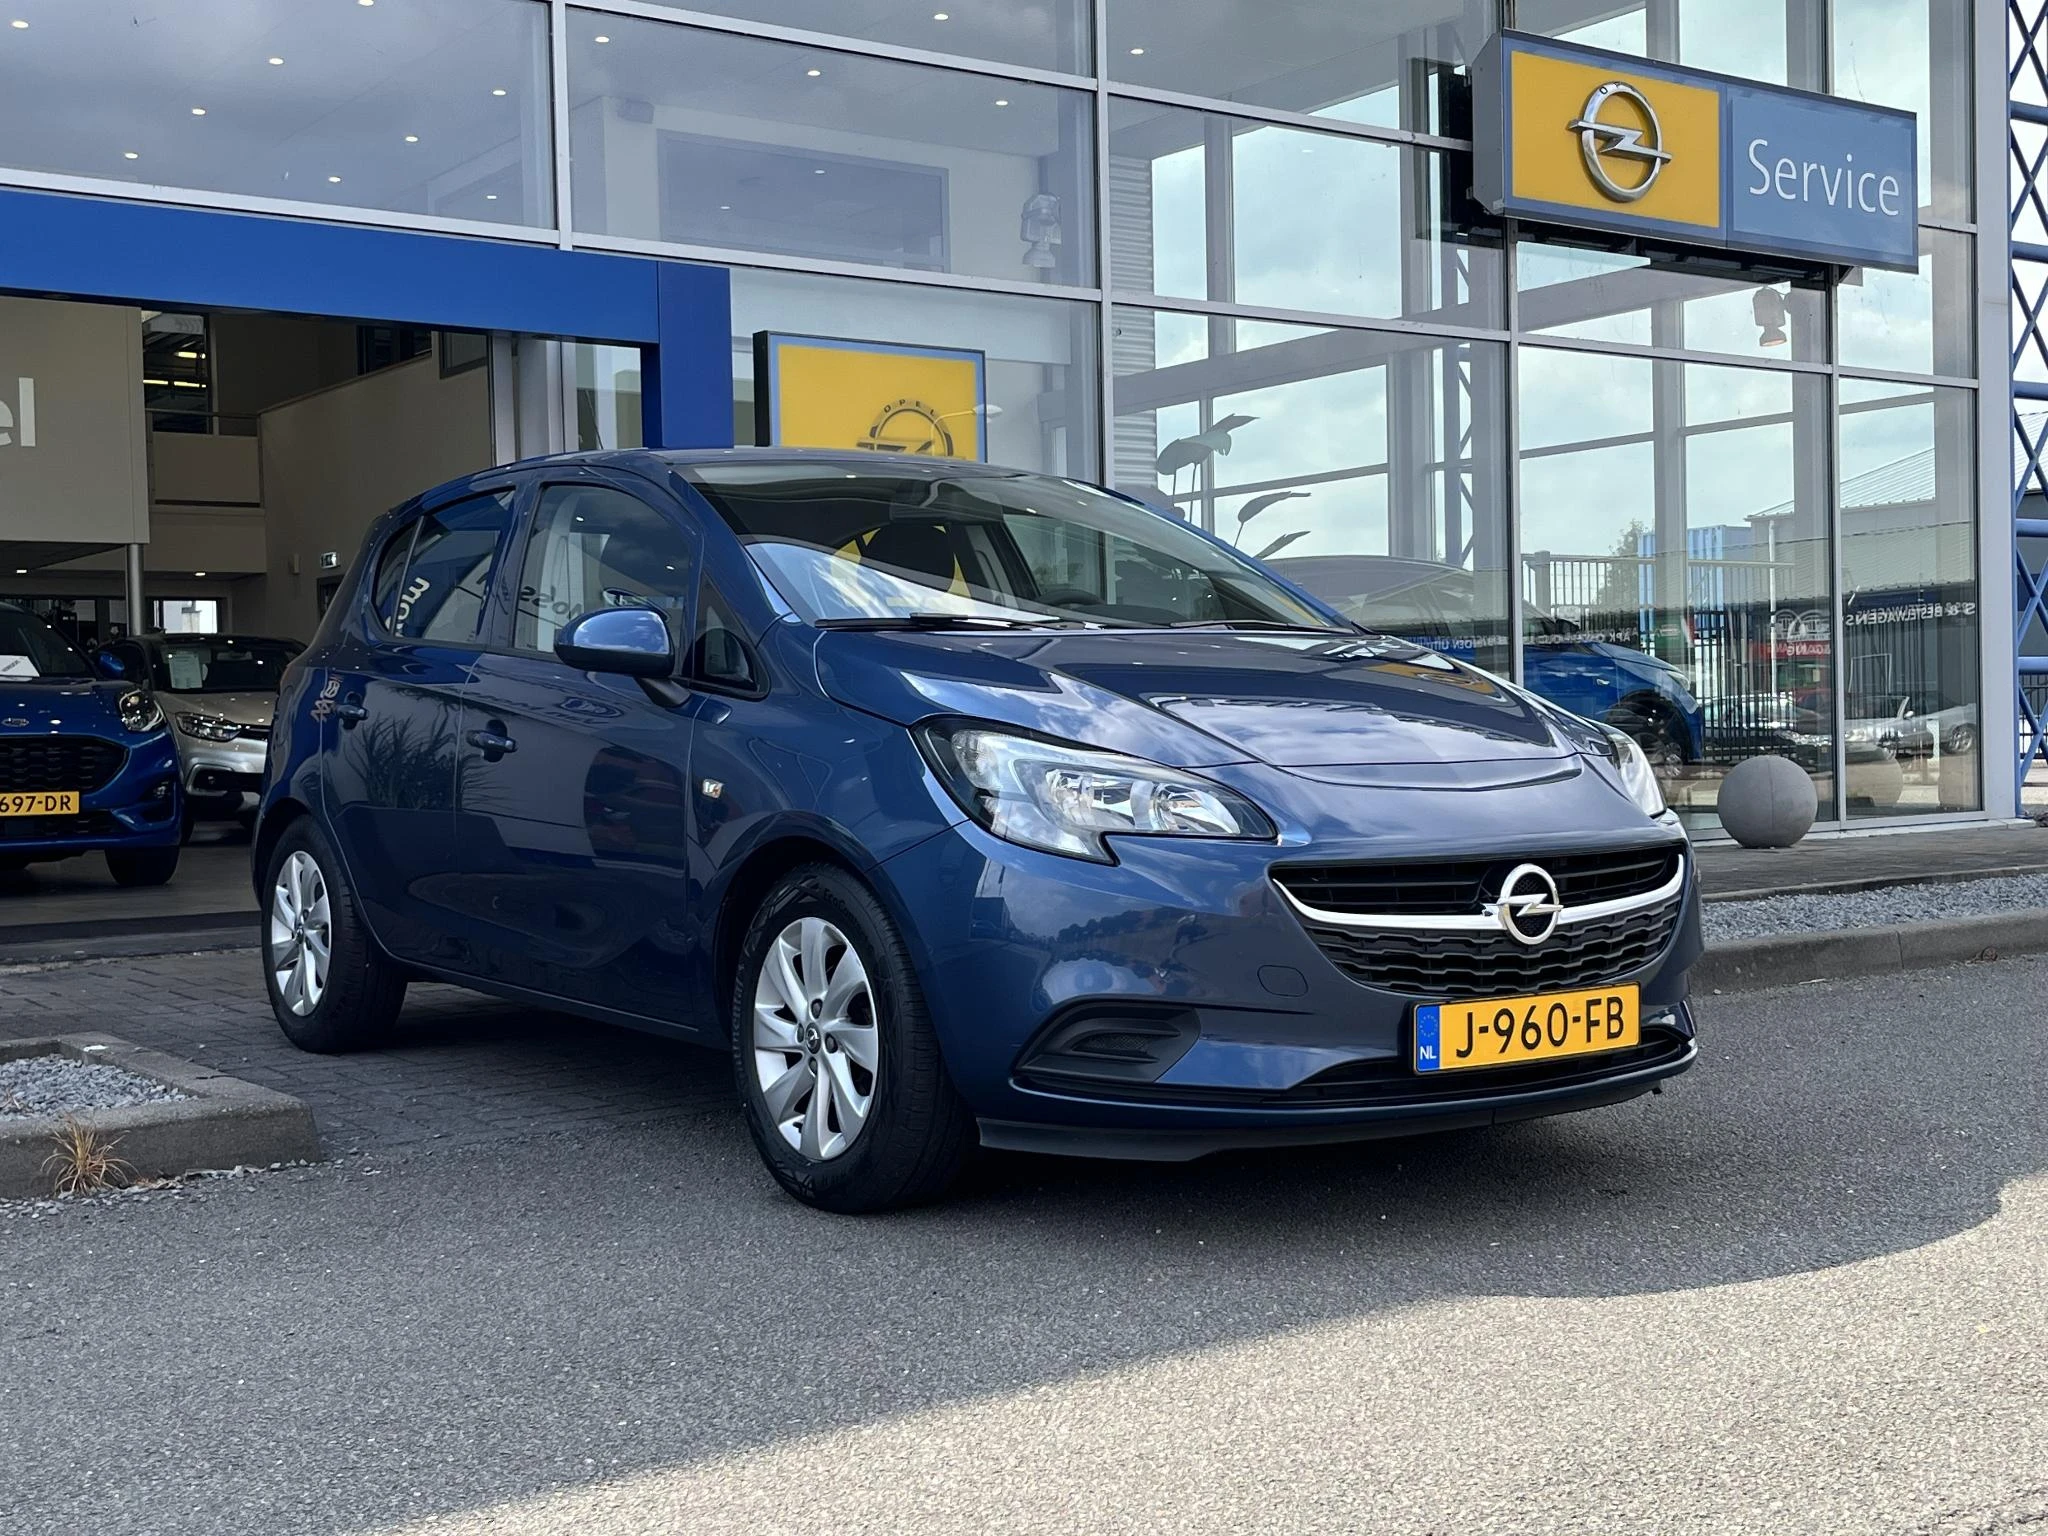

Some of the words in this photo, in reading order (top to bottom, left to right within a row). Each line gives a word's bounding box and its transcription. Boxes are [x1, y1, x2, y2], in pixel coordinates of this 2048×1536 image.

[1748, 138, 1899, 216] Service
[883, 398, 936, 417] OPEL
[1455, 996, 1624, 1059] J-960-FB
[1419, 1044, 1437, 1060] NL
